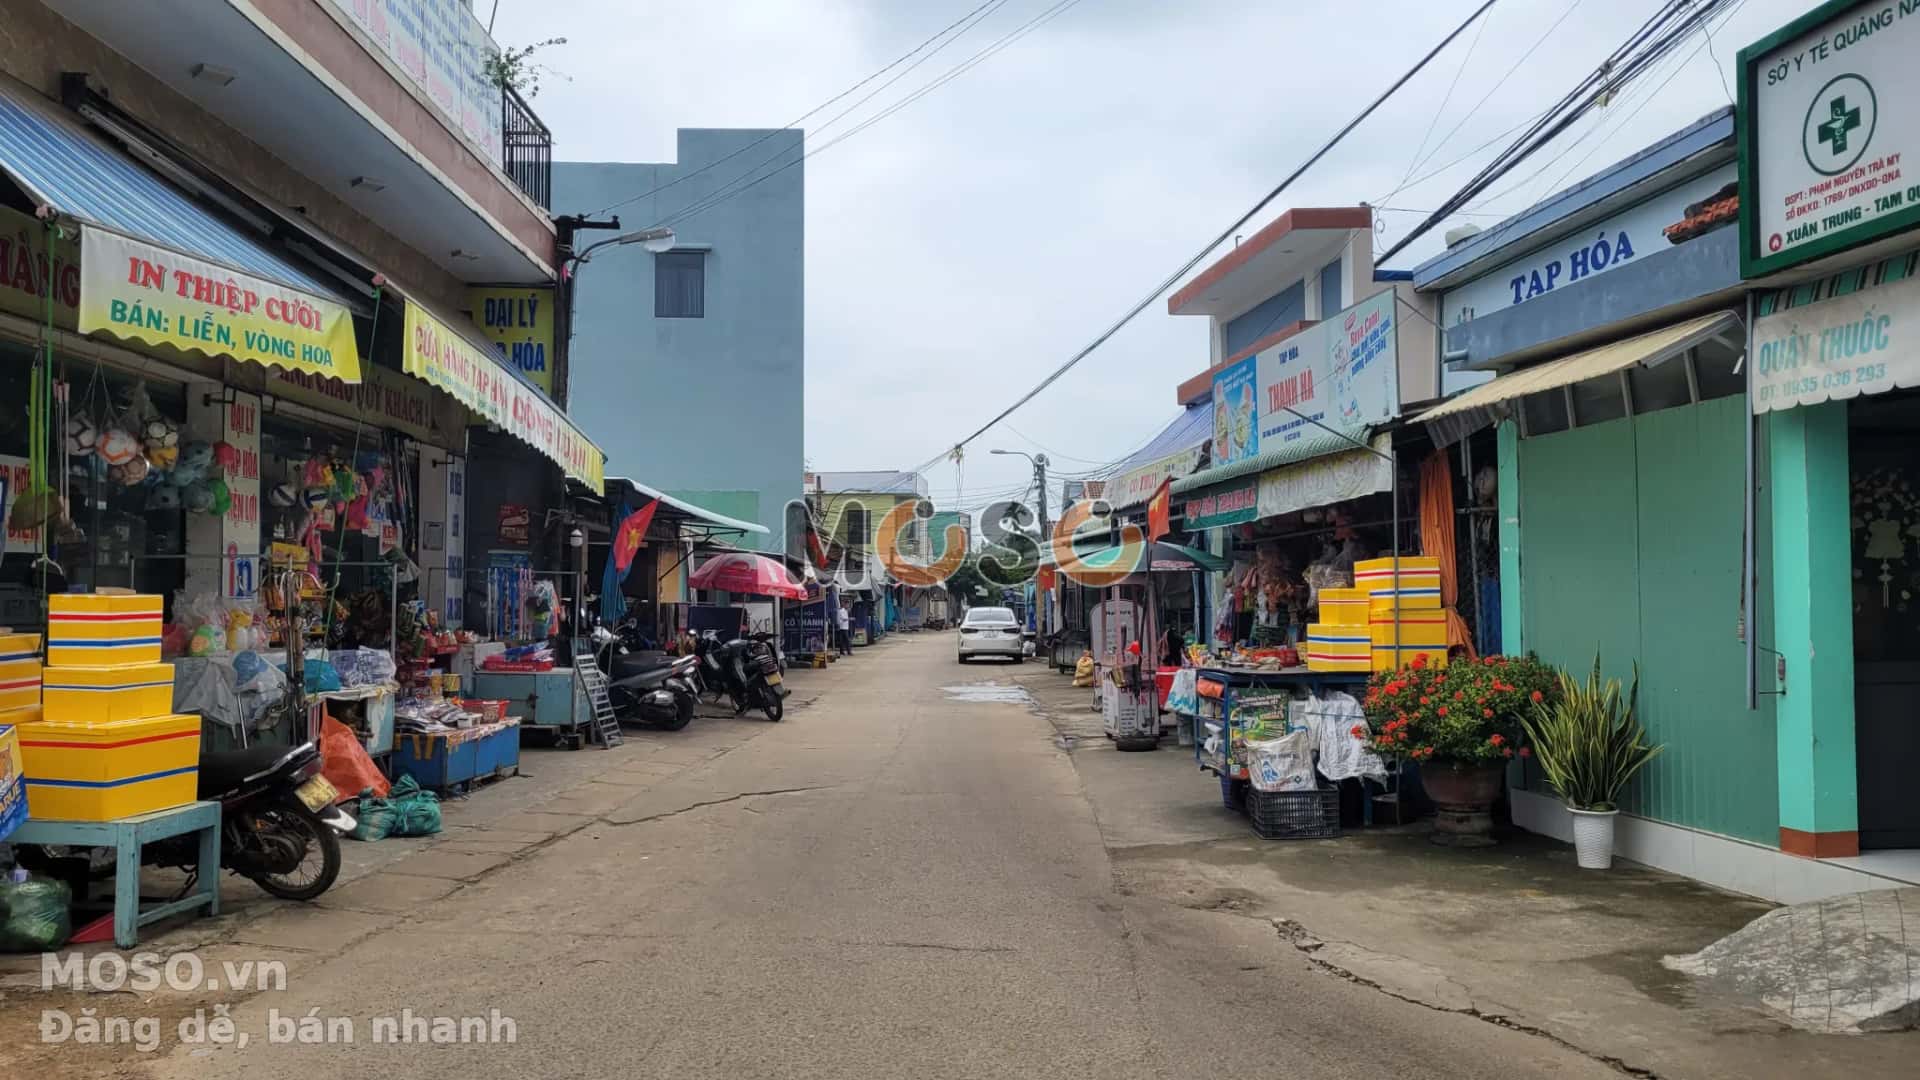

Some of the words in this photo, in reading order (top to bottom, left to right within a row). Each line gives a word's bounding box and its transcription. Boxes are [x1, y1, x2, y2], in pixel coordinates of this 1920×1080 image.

[1767, 60, 1789, 87] SỞ
[1795, 53, 1805, 72] Y
[1809, 35, 1829, 65] TẾ
[1834, 7, 1894, 51] QUẢNG
[1786, 220, 1818, 244] XUÂN
[1822, 206, 1862, 231] TRUNG
[1874, 191, 1903, 213] TAM
[1569, 231, 1636, 282] HÓA
[128, 257, 166, 291] IN
[173, 270, 259, 316] THIỆP
[264, 294, 323, 333] CƯỚI
[518, 293, 539, 329] LÝ
[111, 297, 170, 334] BÁN:
[178, 310, 236, 351] LIỄN,
[245, 328, 296, 359] VÒNG
[301, 344, 333, 368] HOA
[1819, 304, 1891, 363] THUỐC
[1855, 362, 1886, 384] 293
